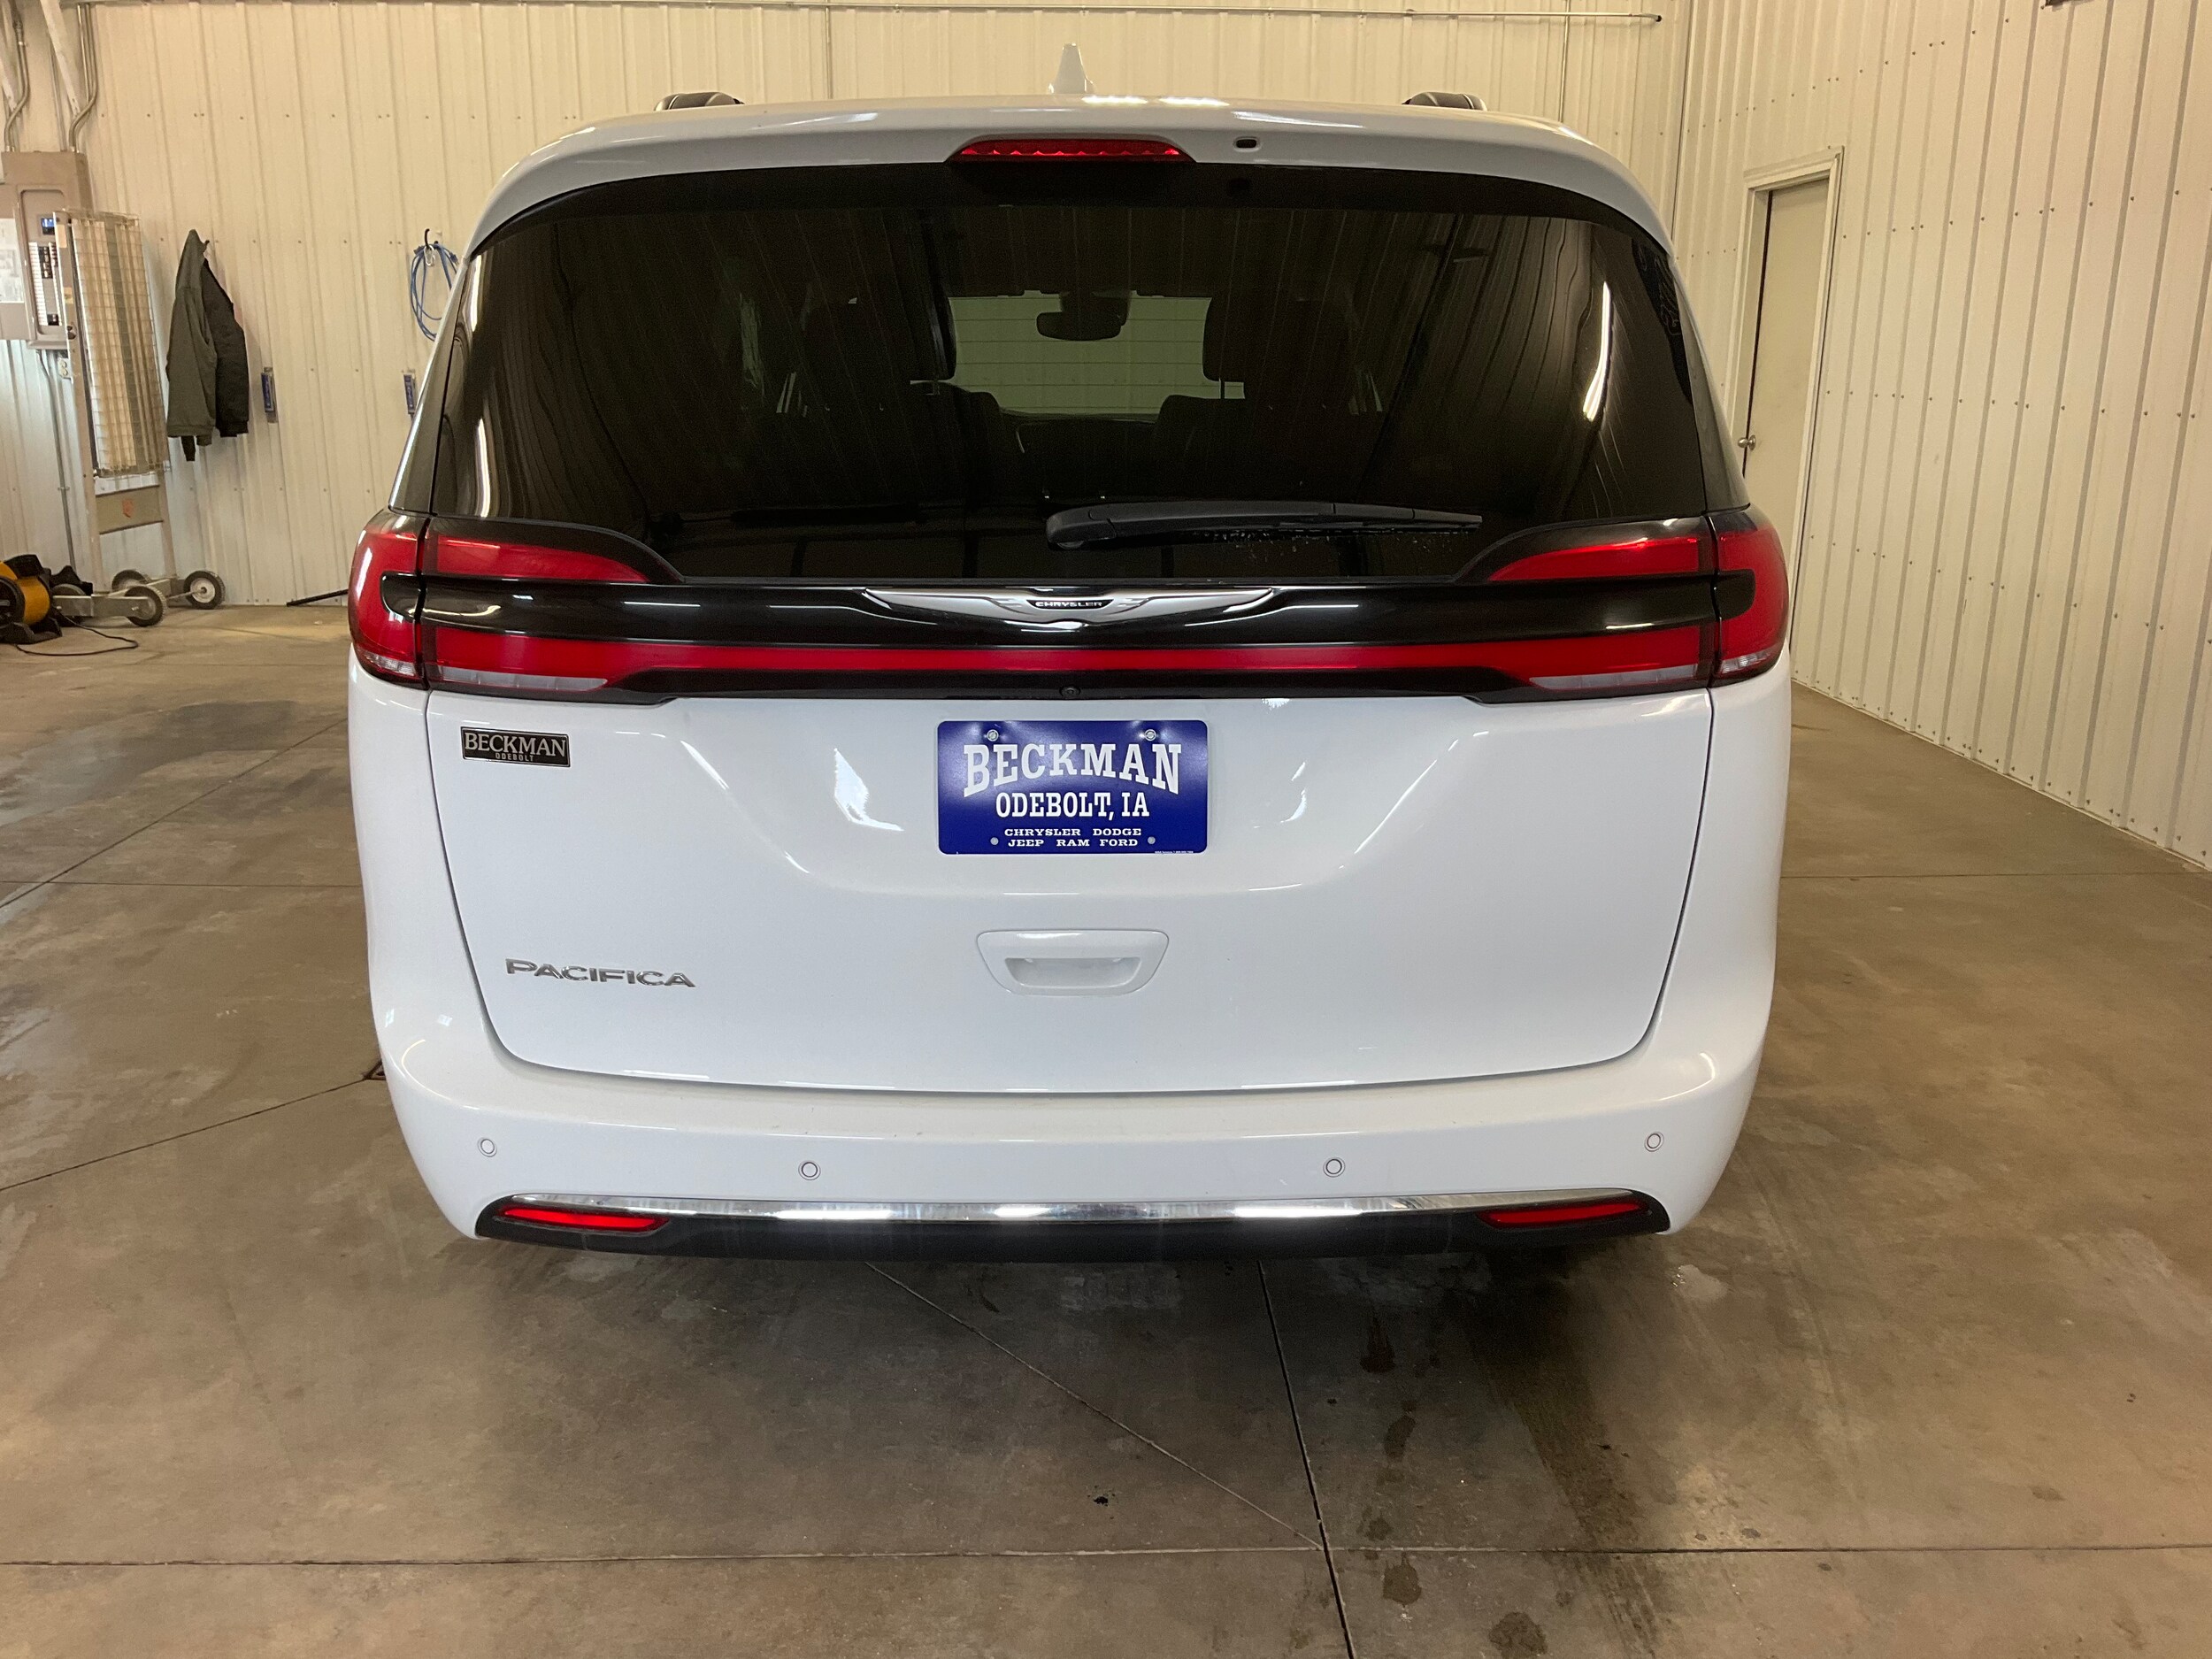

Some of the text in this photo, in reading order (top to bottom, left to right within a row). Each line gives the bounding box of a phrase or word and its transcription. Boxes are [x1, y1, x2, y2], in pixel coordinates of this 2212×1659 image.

[465, 732, 566, 757] BECKMAN
[495, 752, 534, 762] ODEBOLT
[964, 743, 1182, 798] BECKMAN
[995, 792, 1150, 821] ODEBOLT, IA
[1004, 828, 1141, 837] CHRYSLER DODGE
[1008, 838, 1139, 848] JEEP RAM FORD
[504, 958, 696, 987] PACIFICA
